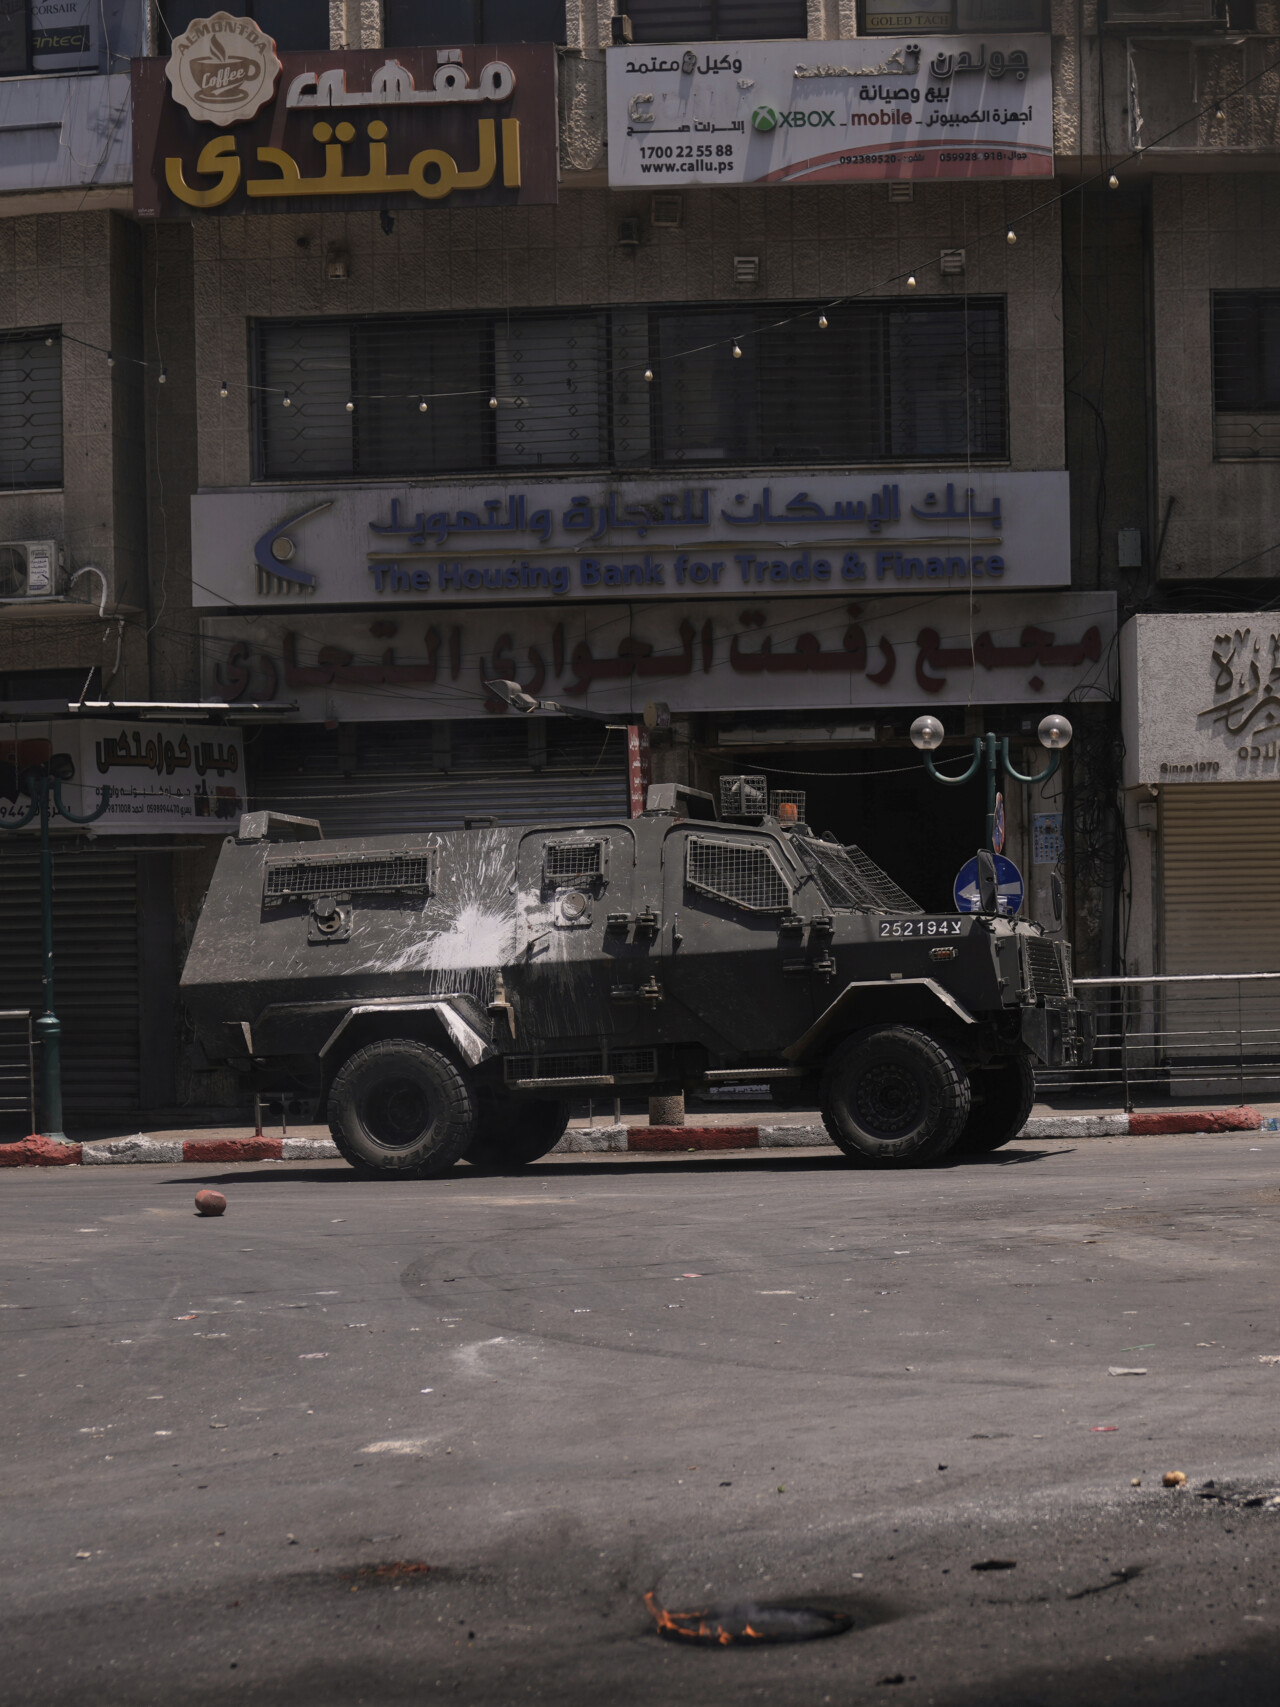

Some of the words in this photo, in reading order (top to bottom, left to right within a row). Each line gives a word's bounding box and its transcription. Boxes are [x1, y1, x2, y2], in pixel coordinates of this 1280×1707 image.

[31, 3, 77, 16] CORSAIR
[626, 57, 680, 74] معتمد
[697, 55, 742, 75] وكيل
[930, 43, 1029, 81] جولدن
[202, 67, 245, 88] Coffee
[859, 85, 920, 103] وصيانة
[924, 85, 950, 103] بيع
[778, 109, 835, 129] XBOX
[851, 108, 913, 126] mobile
[926, 109, 990, 127] الكمبيوتر
[992, 105, 1033, 126] أجهزة
[640, 146, 673, 159] 1700
[676, 146, 693, 158] 22
[696, 145, 712, 157] 55
[716, 144, 733, 157] 88
[840, 155, 896, 164] 092389520
[940, 152, 1003, 162] 059928918
[165, 118, 521, 208] المنتدى
[641, 159, 734, 174] www.callu.ps
[563, 488, 710, 540] للتجارة
[721, 484, 899, 532] الإسكان
[911, 483, 1001, 529] بنك
[368, 495, 552, 545] والتمويل
[367, 563, 431, 592] The
[438, 561, 570, 595] Housing
[580, 557, 664, 587] Bank
[674, 553, 724, 584] for
[734, 551, 831, 583] Trade
[840, 552, 867, 581] &
[876, 550, 1005, 580] Finance
[730, 603, 896, 686] رفعت
[916, 624, 1101, 694] مجمع
[194, 742, 238, 776] ميس
